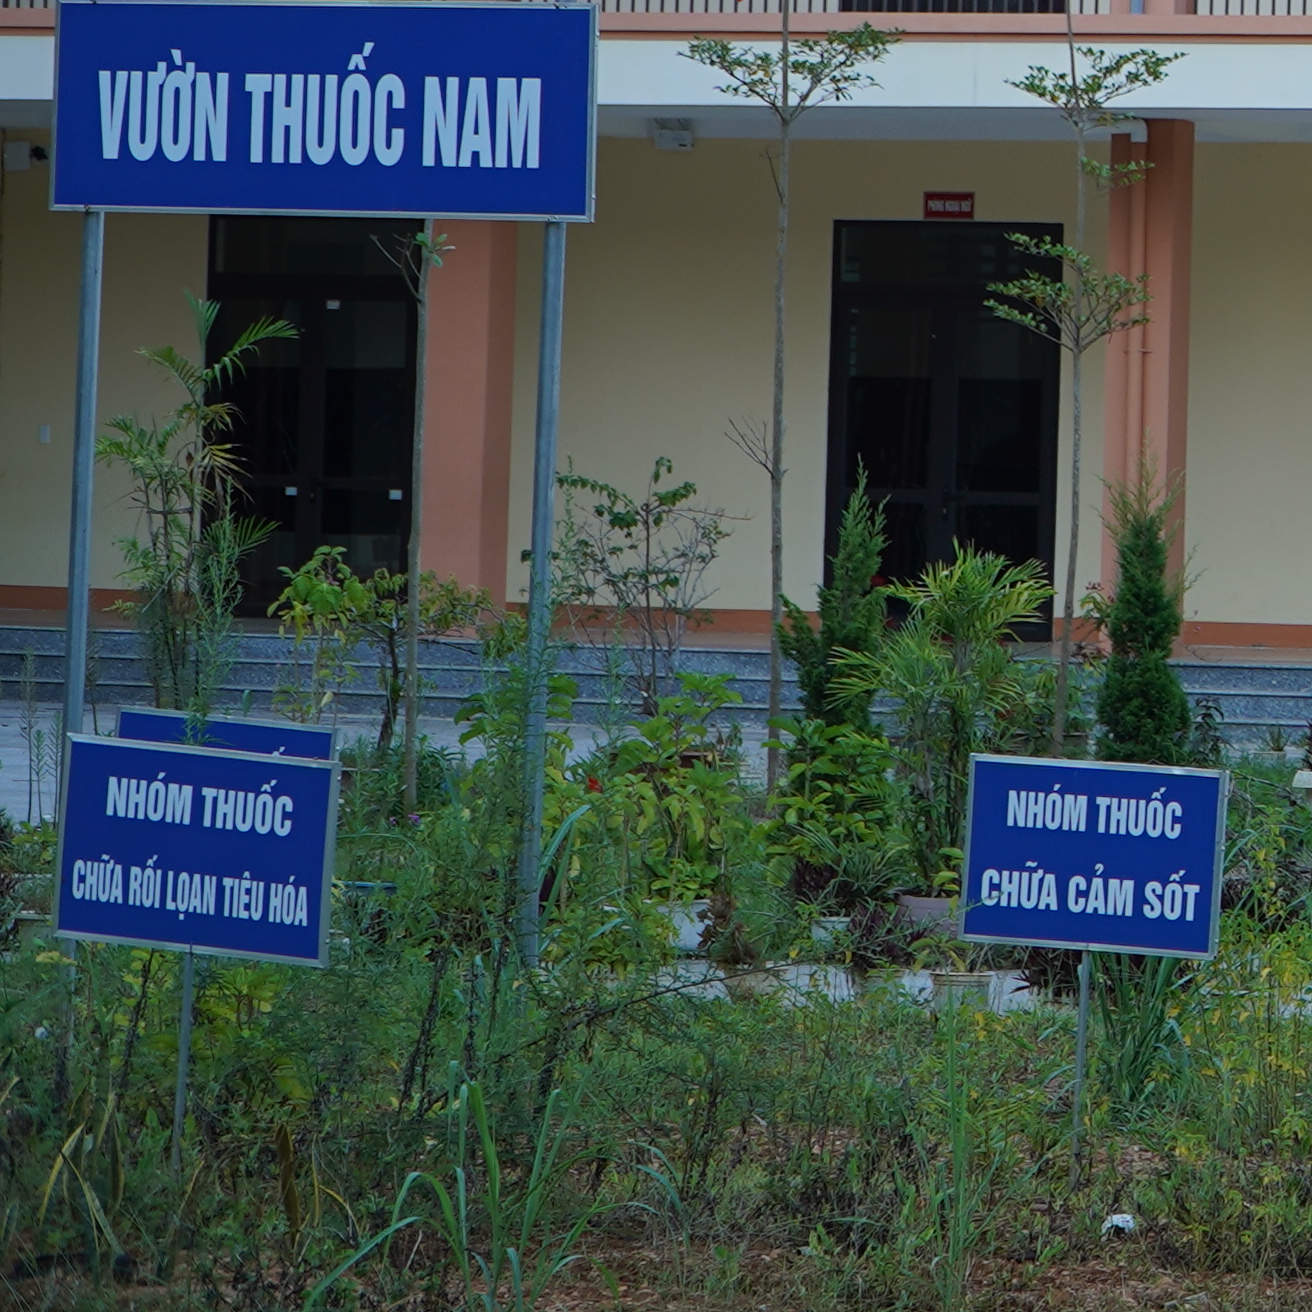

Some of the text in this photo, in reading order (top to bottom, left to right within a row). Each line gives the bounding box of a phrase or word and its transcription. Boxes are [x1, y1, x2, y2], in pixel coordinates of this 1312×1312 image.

[98, 42, 542, 170] VƯỜN THUỐC NAM
[106, 772, 293, 837] NHÓM THUỐC
[1007, 784, 1183, 839] NHÓM THUỐC
[72, 853, 123, 904] CHỮA
[128, 854, 162, 909] RỐI
[222, 870, 265, 921] TIÊU
[268, 875, 308, 927] HÓA
[981, 860, 1200, 921] CHỮA CẢM SỐT
